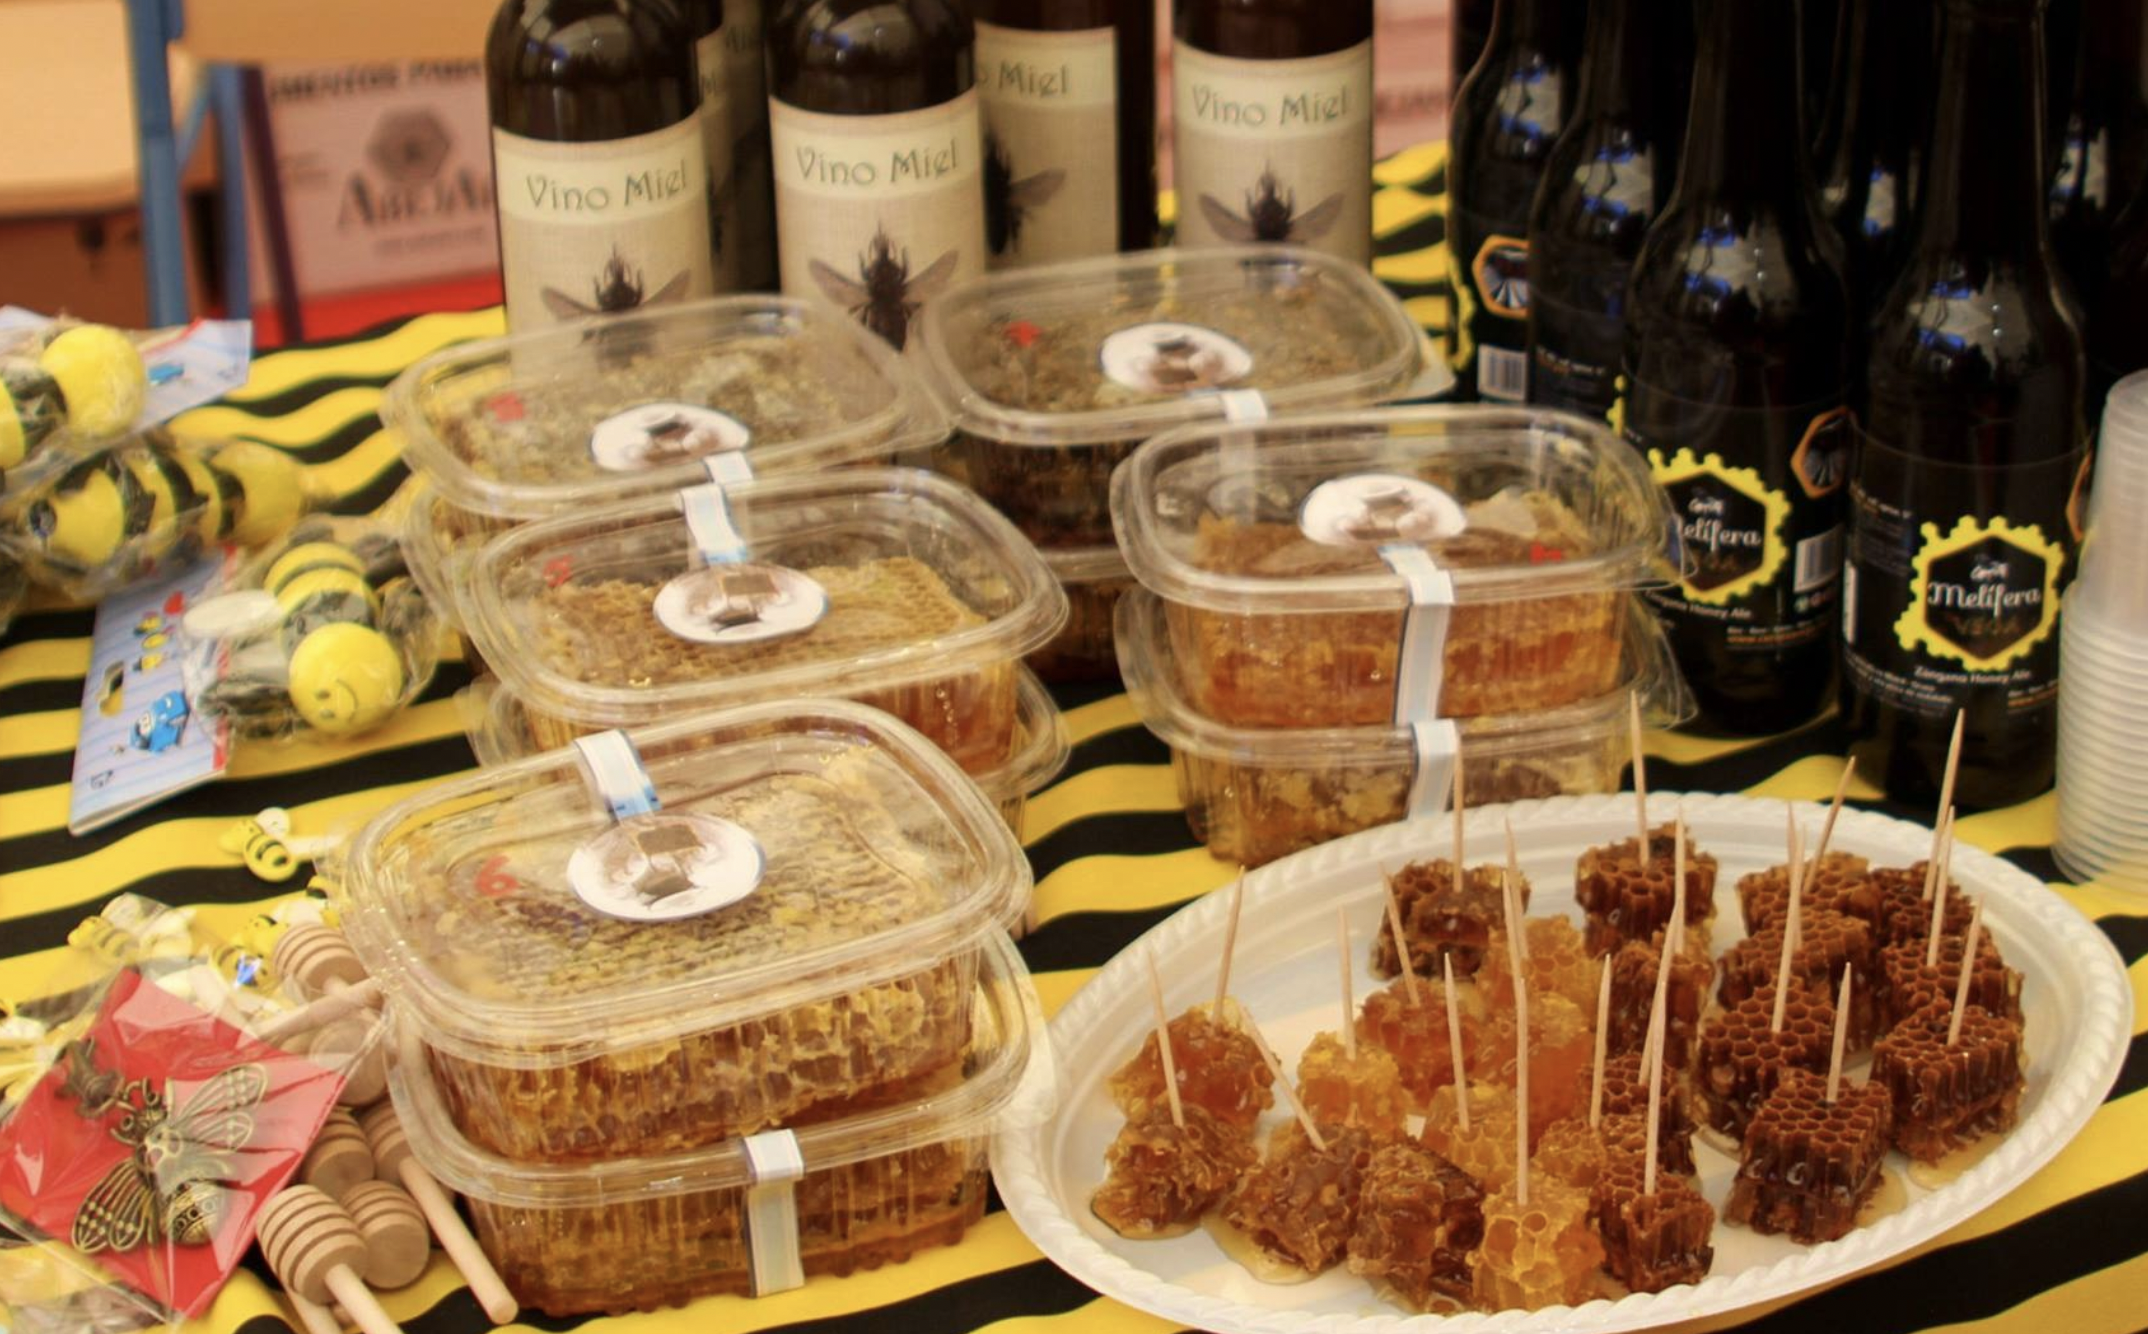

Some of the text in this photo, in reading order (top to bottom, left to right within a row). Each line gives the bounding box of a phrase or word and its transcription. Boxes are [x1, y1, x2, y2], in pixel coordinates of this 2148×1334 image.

[998, 59, 1067, 97] Miel
[1191, 85, 1267, 127] Vino
[1279, 84, 1347, 125] Miel
[796, 137, 957, 186] Vino Miel
[526, 157, 686, 212] Vino Miel
[1683, 518, 1763, 553] elífera
